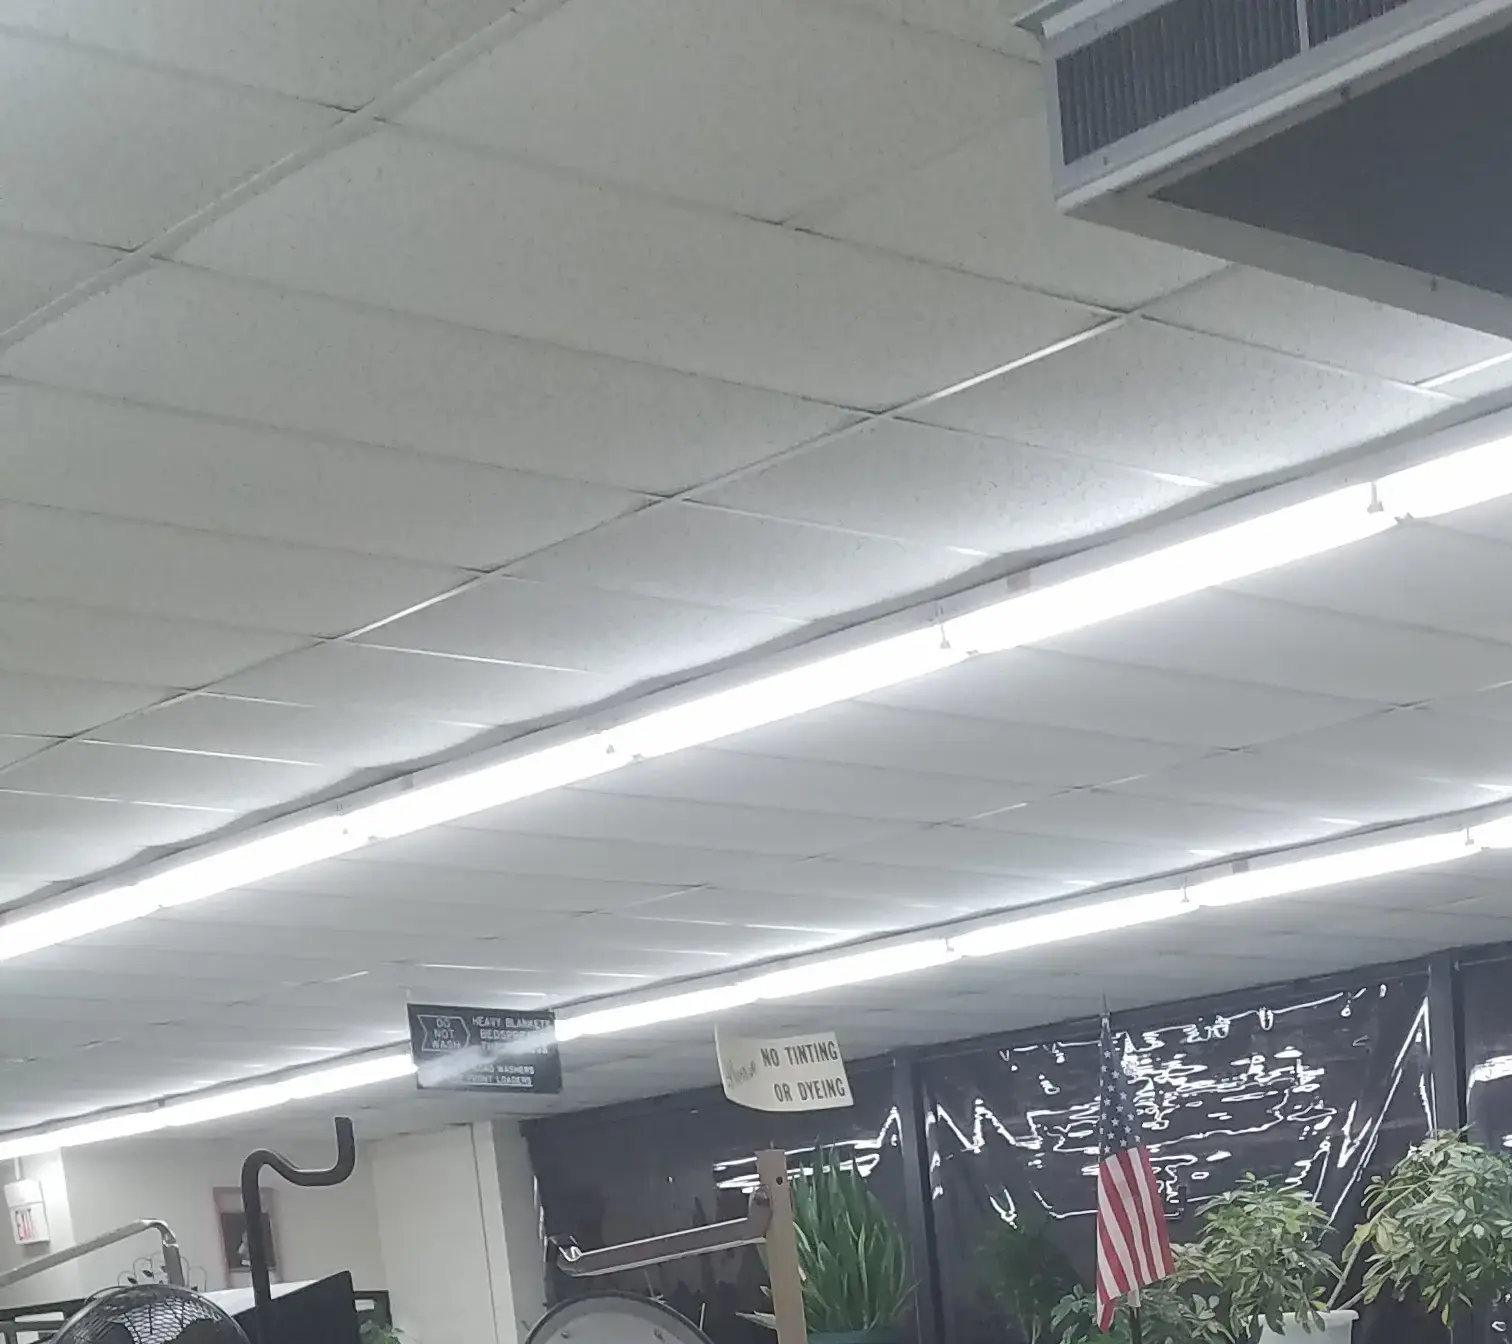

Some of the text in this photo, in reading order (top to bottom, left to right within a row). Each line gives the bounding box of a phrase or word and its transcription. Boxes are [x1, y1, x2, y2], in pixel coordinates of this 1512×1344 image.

[472, 1016, 501, 1028] HEAVY
[434, 1029, 455, 1039] NOT
[432, 1040, 461, 1049] WASH
[760, 1048, 780, 1067] NO
[784, 1041, 839, 1066] TINTING
[497, 1065, 535, 1075] WASHERS
[496, 1076, 533, 1085] LOADERS
[773, 1077, 846, 1102] OR DYEING
